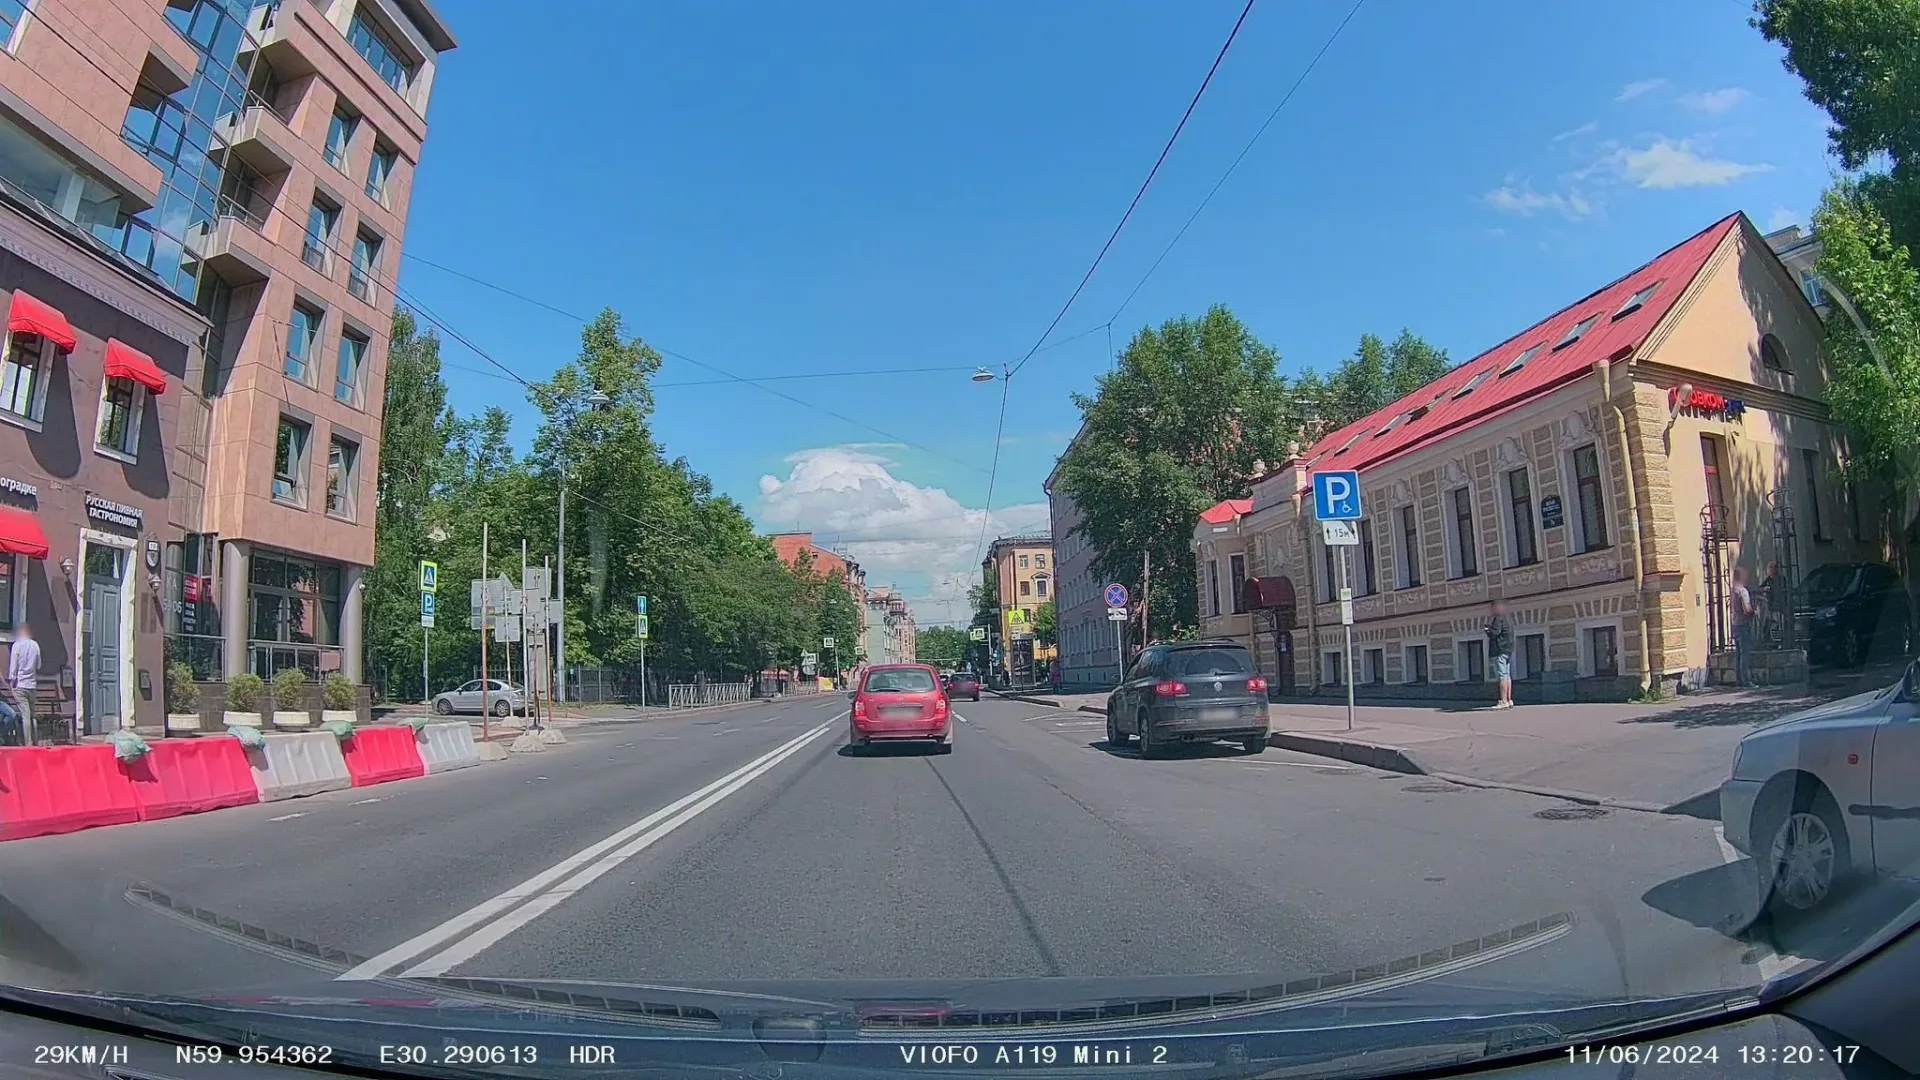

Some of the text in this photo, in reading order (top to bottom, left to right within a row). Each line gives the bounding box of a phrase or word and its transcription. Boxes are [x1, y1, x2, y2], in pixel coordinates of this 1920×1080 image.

[0, 476, 37, 496] оградке
[1325, 476, 1350, 514] P
[85, 494, 143, 518] РУССКАЯ ПИВНАЯ
[89, 507, 138, 528] ГАСТРОНОМИЯ
